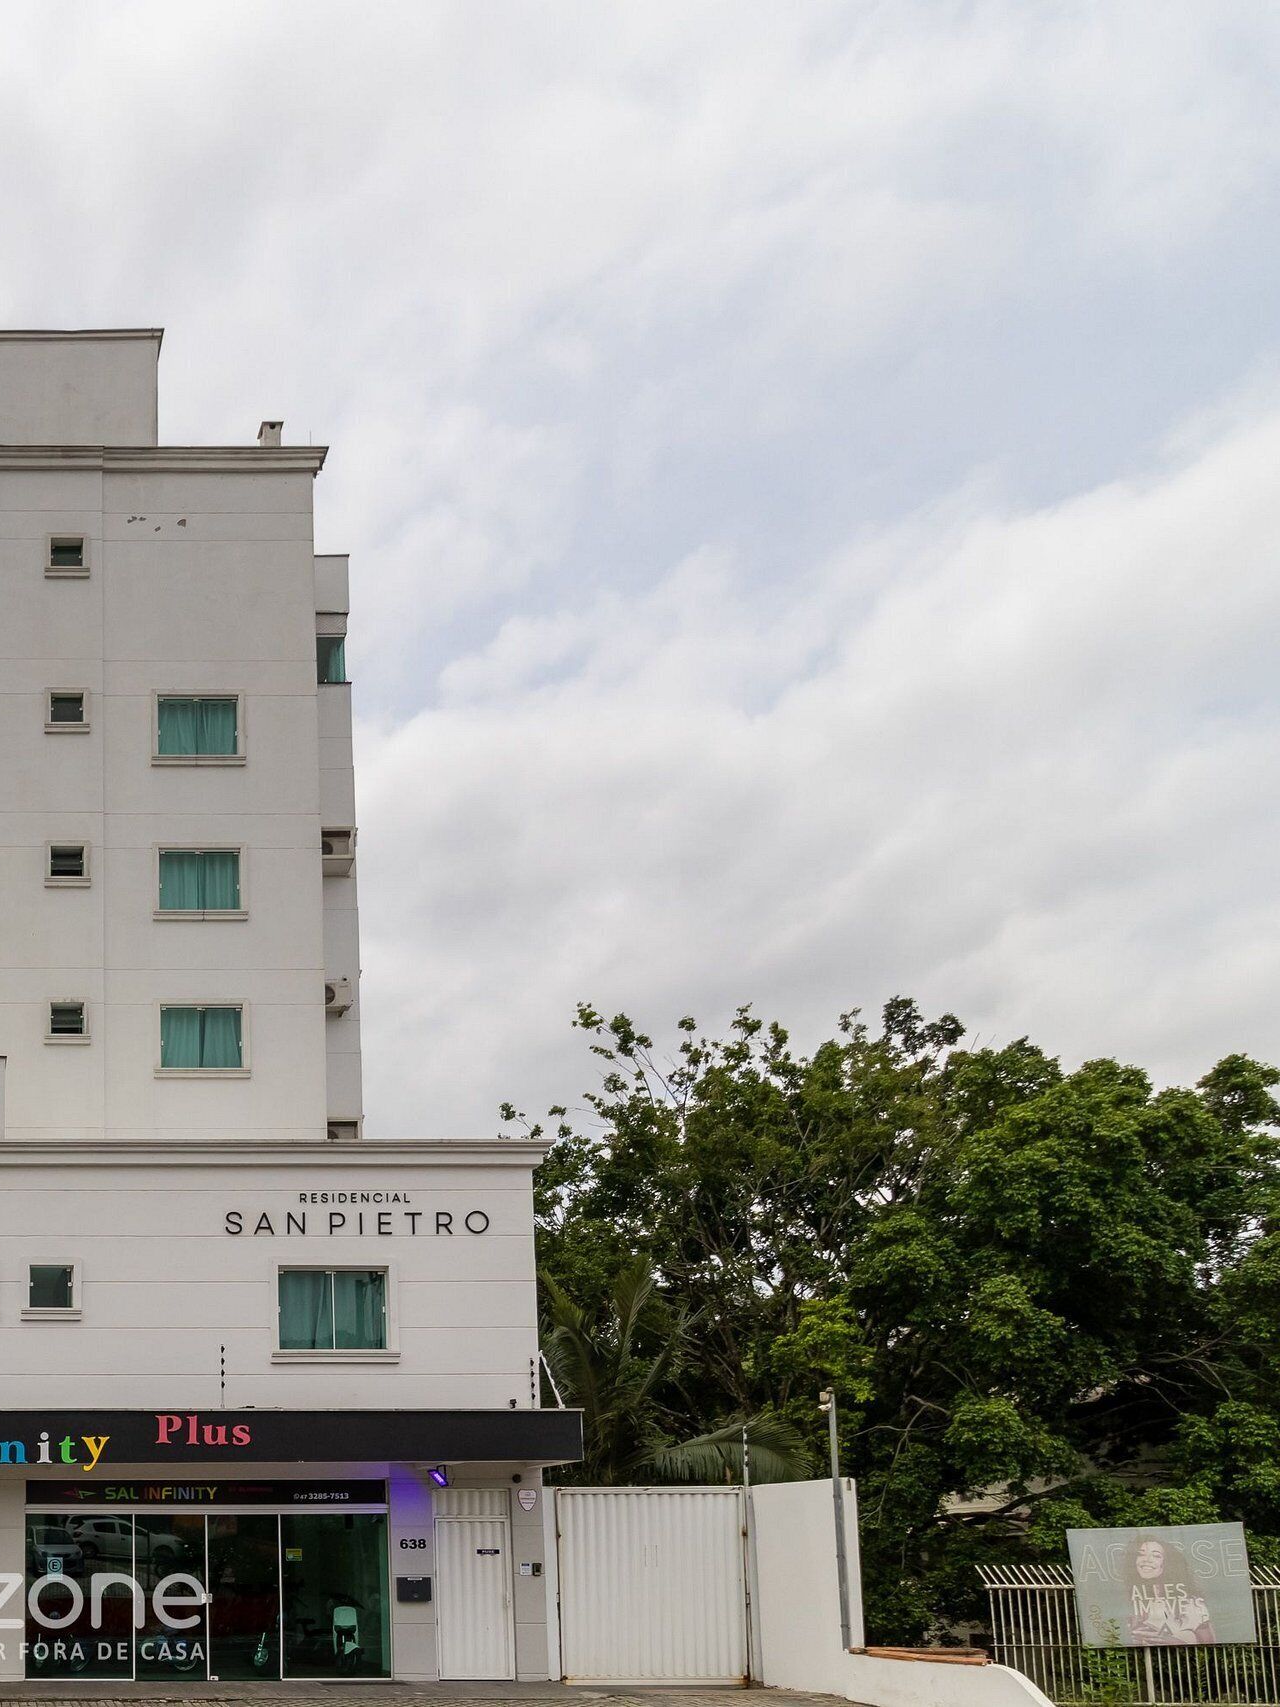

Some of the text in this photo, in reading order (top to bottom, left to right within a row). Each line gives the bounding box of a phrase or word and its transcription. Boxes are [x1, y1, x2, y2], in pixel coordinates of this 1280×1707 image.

[299, 1192, 411, 1204] RESIDENCIAL
[225, 1210, 490, 1235] SAN PIETRO
[154, 1414, 251, 1447] Plus
[105, 1487, 139, 1500] SAL
[143, 1487, 217, 1500] INFINITY
[400, 1539, 427, 1549] 638
[1078, 1538, 1248, 1582] ACSE
[1131, 1583, 1187, 1600] ALLES
